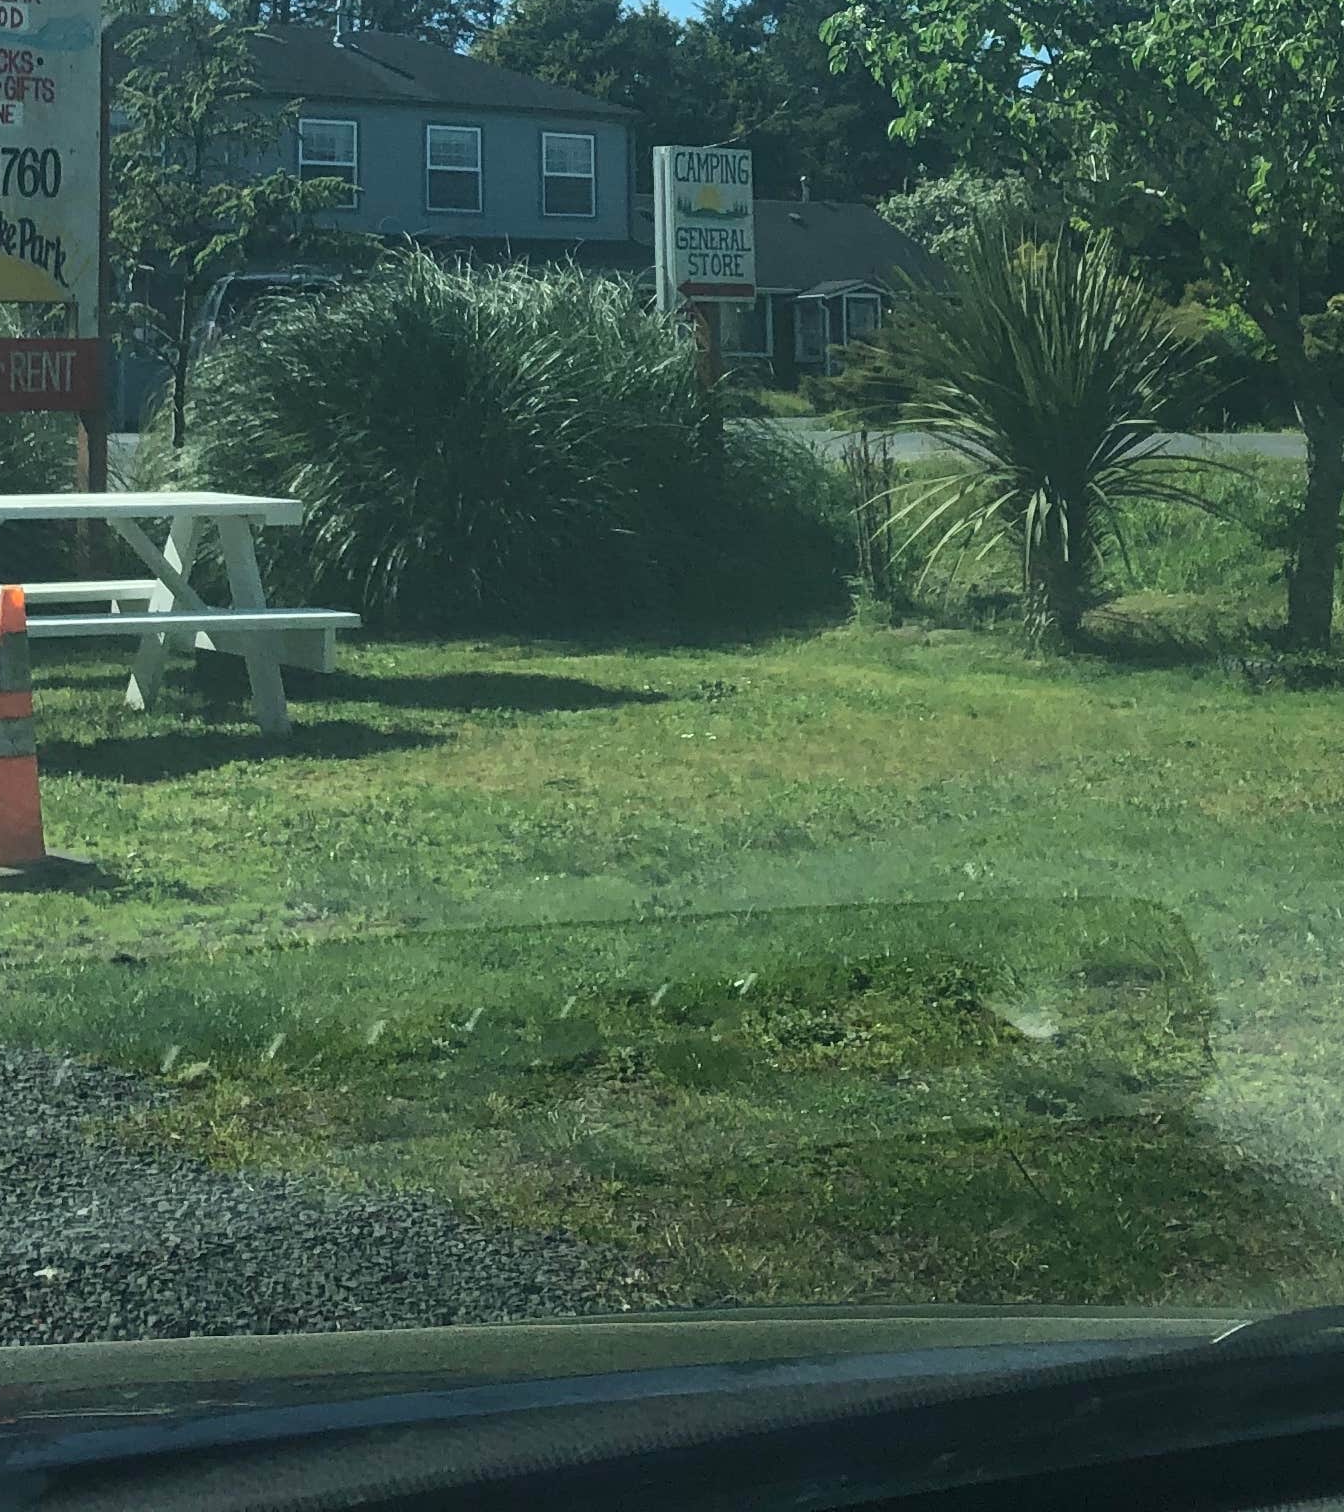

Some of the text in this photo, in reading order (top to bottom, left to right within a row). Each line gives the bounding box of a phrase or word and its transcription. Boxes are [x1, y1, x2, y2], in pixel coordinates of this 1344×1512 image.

[674, 151, 750, 185] CAMPING
[18, 217, 70, 288] Park
[675, 226, 752, 252] GENERAL
[687, 253, 745, 278] STORE
[8, 350, 77, 393] RENT
